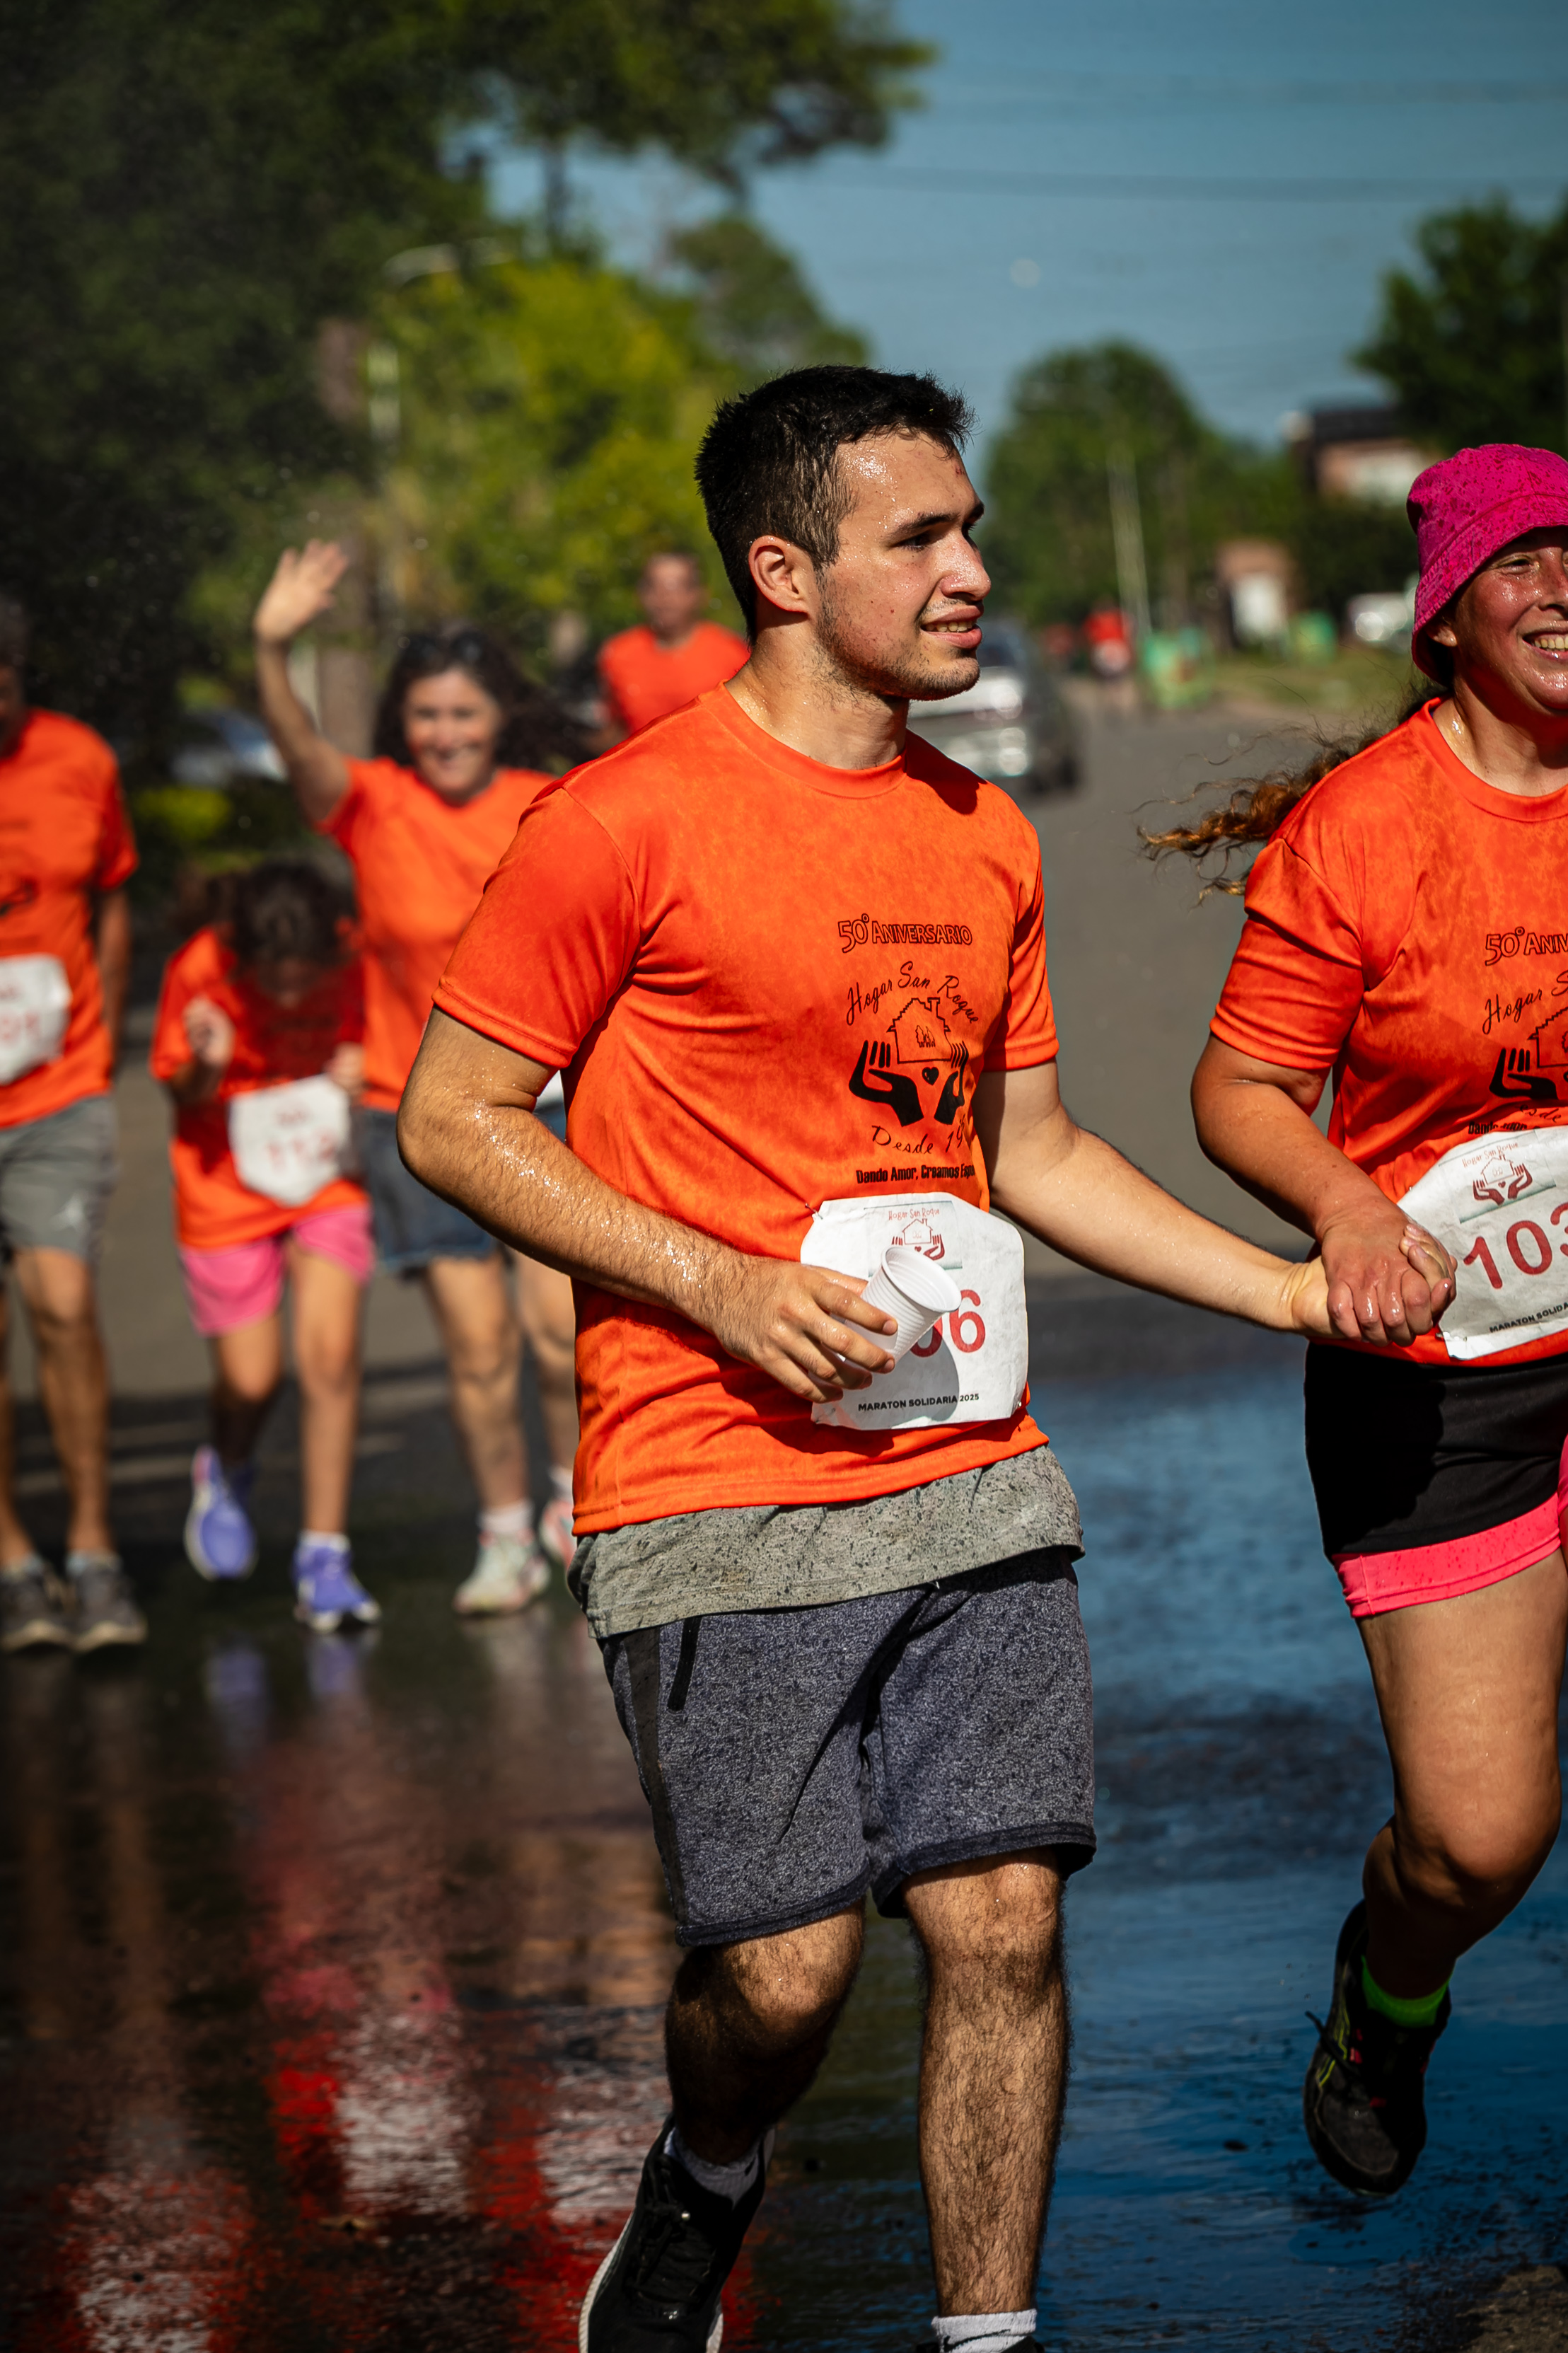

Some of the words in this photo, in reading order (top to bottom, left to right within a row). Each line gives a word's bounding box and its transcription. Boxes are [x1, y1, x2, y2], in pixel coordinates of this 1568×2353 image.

[846, 979, 893, 1026] Hogar
[898, 961, 931, 989] San
[936, 975, 979, 1024] Roque
[1482, 989, 1542, 1035] Hogar
[871, 1125, 934, 1154] Desde
[856, 1167, 888, 1184] Dando
[890, 1167, 919, 1181] Amor,
[921, 1164, 960, 1179] Creamos
[888, 1210, 908, 1221] Hogar
[1489, 1314, 1535, 1334] MARATON
[858, 1399, 907, 1411] MARATON
[908, 1394, 958, 1407] SOLIDARIA
[959, 1393, 980, 1402] 2025
